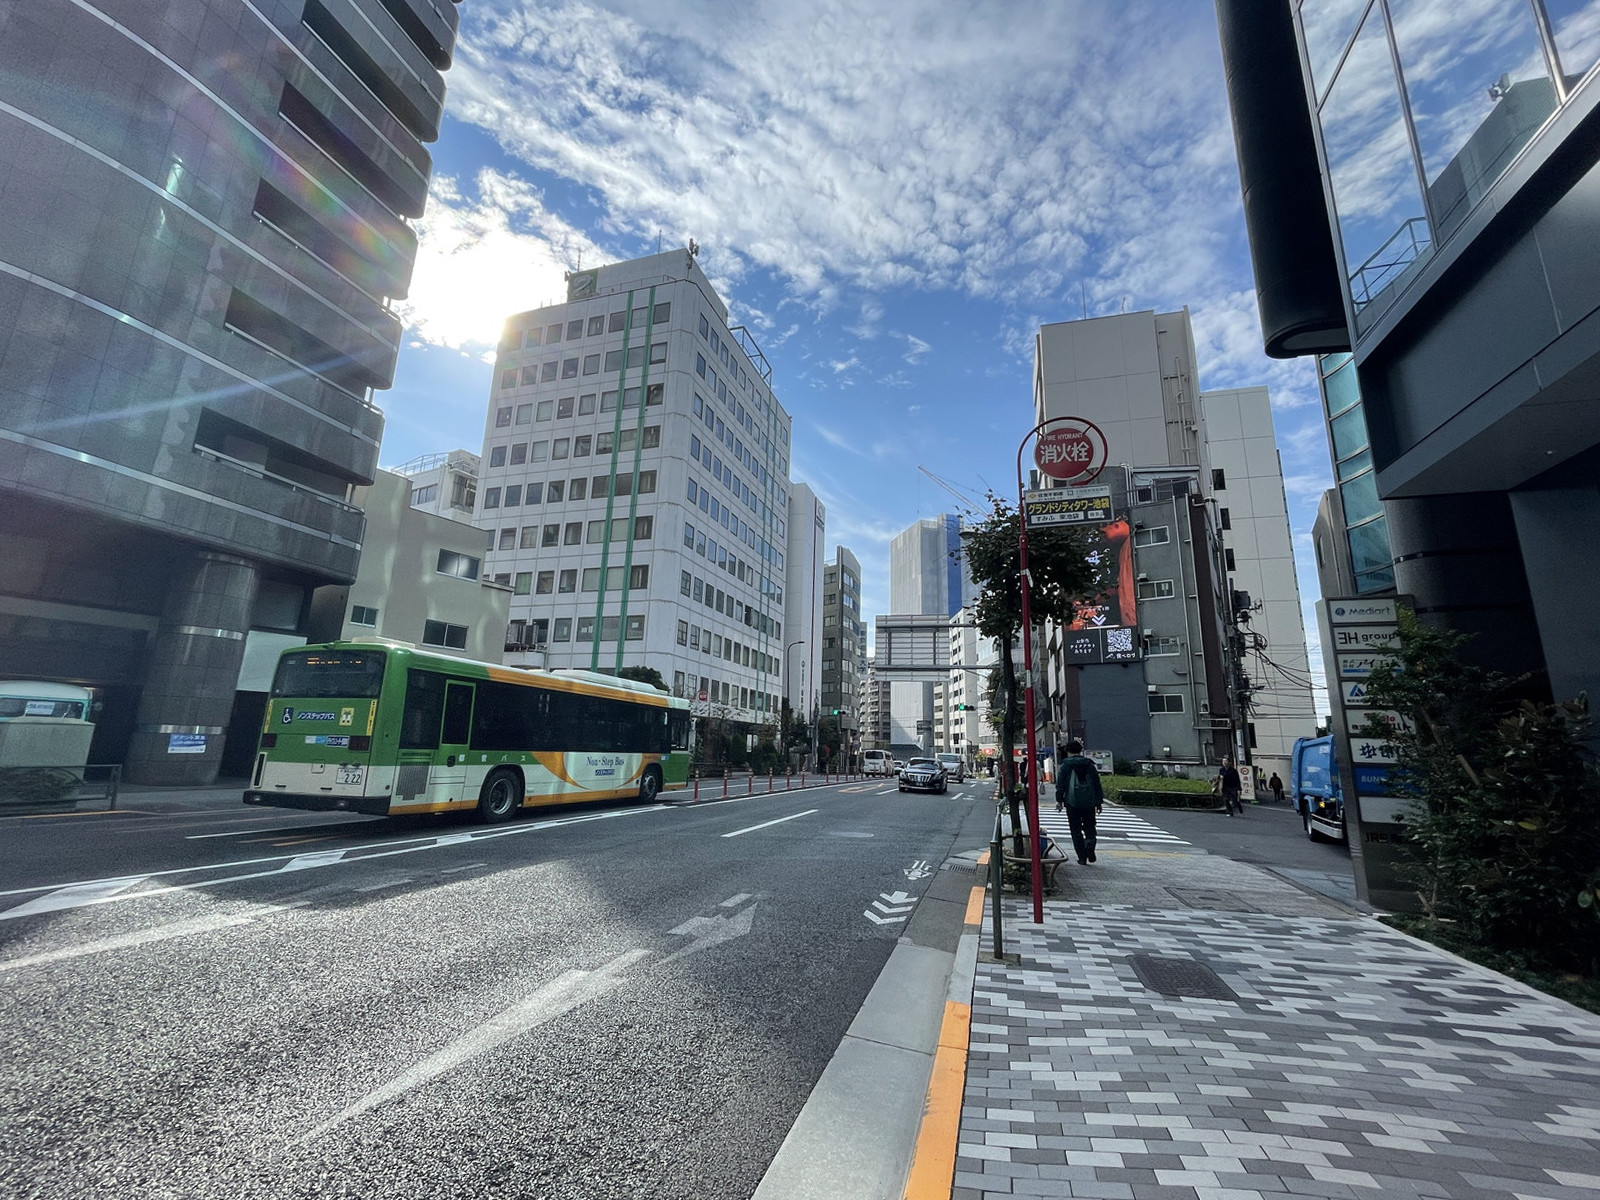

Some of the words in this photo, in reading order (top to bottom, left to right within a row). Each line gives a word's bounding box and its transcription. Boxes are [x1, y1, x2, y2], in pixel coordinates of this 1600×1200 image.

[1040, 441, 1090, 464] 消火栓
[1028, 498, 1110, 515] グランドシティタワー池袋
[1349, 607, 1390, 616] Mediart
[1361, 632, 1397, 642] group
[297, 712, 336, 720] ノンステップバス
[614, 757, 624, 765] Bus
